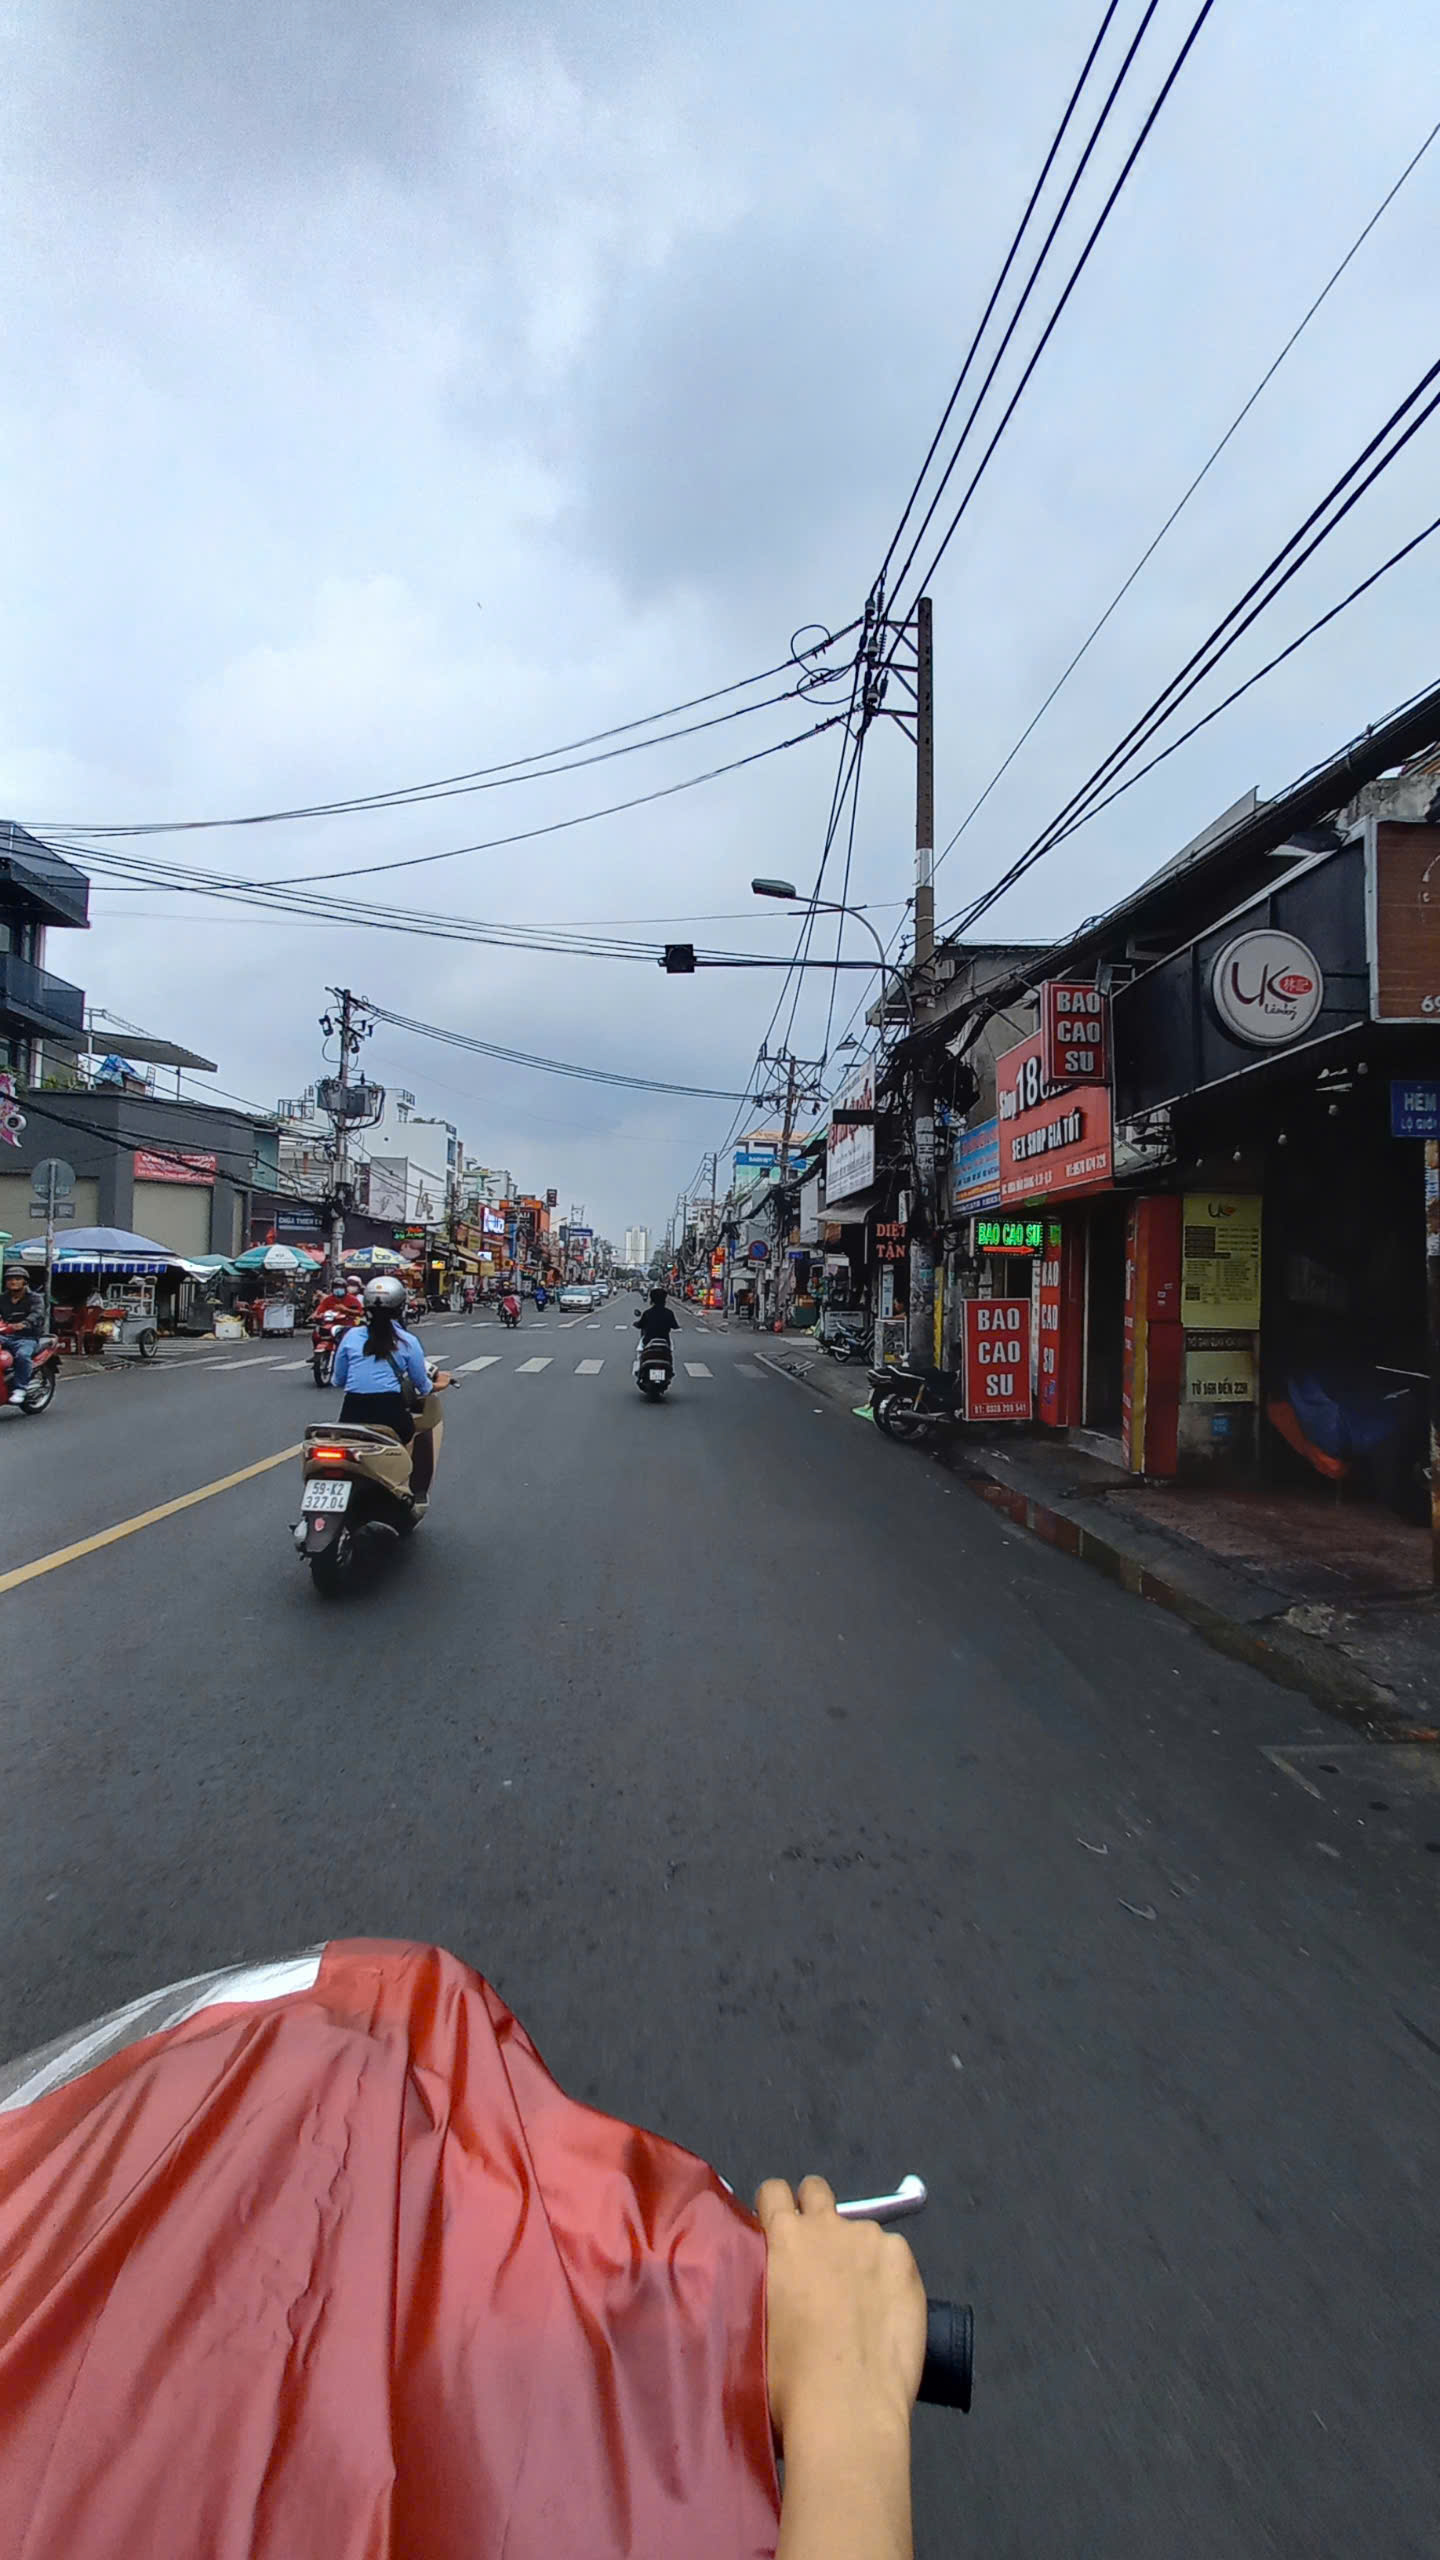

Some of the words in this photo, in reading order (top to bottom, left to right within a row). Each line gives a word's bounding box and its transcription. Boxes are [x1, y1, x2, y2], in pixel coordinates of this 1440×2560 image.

[1056, 991, 1100, 1014] BAO
[1057, 1020, 1100, 1042] CAO
[1065, 1050, 1094, 1072] SU
[1012, 1136, 1027, 1161] SEX
[1027, 1128, 1046, 1156] SHOP
[1048, 1116, 1062, 1149] GIÁ
[1062, 1106, 1080, 1145] TỐT
[876, 1220, 907, 1240] DIỆT
[978, 1223, 1000, 1245] BAO
[1002, 1223, 1024, 1246] CAO
[1025, 1224, 1041, 1247] SU
[876, 1240, 906, 1260] TẬN
[1041, 1261, 1059, 1287] BAO
[977, 1308, 1020, 1331] BAO
[1041, 1304, 1059, 1330] CAO
[978, 1340, 1021, 1364] CAO
[1043, 1347, 1055, 1374] SU
[986, 1373, 1014, 1396] SU
